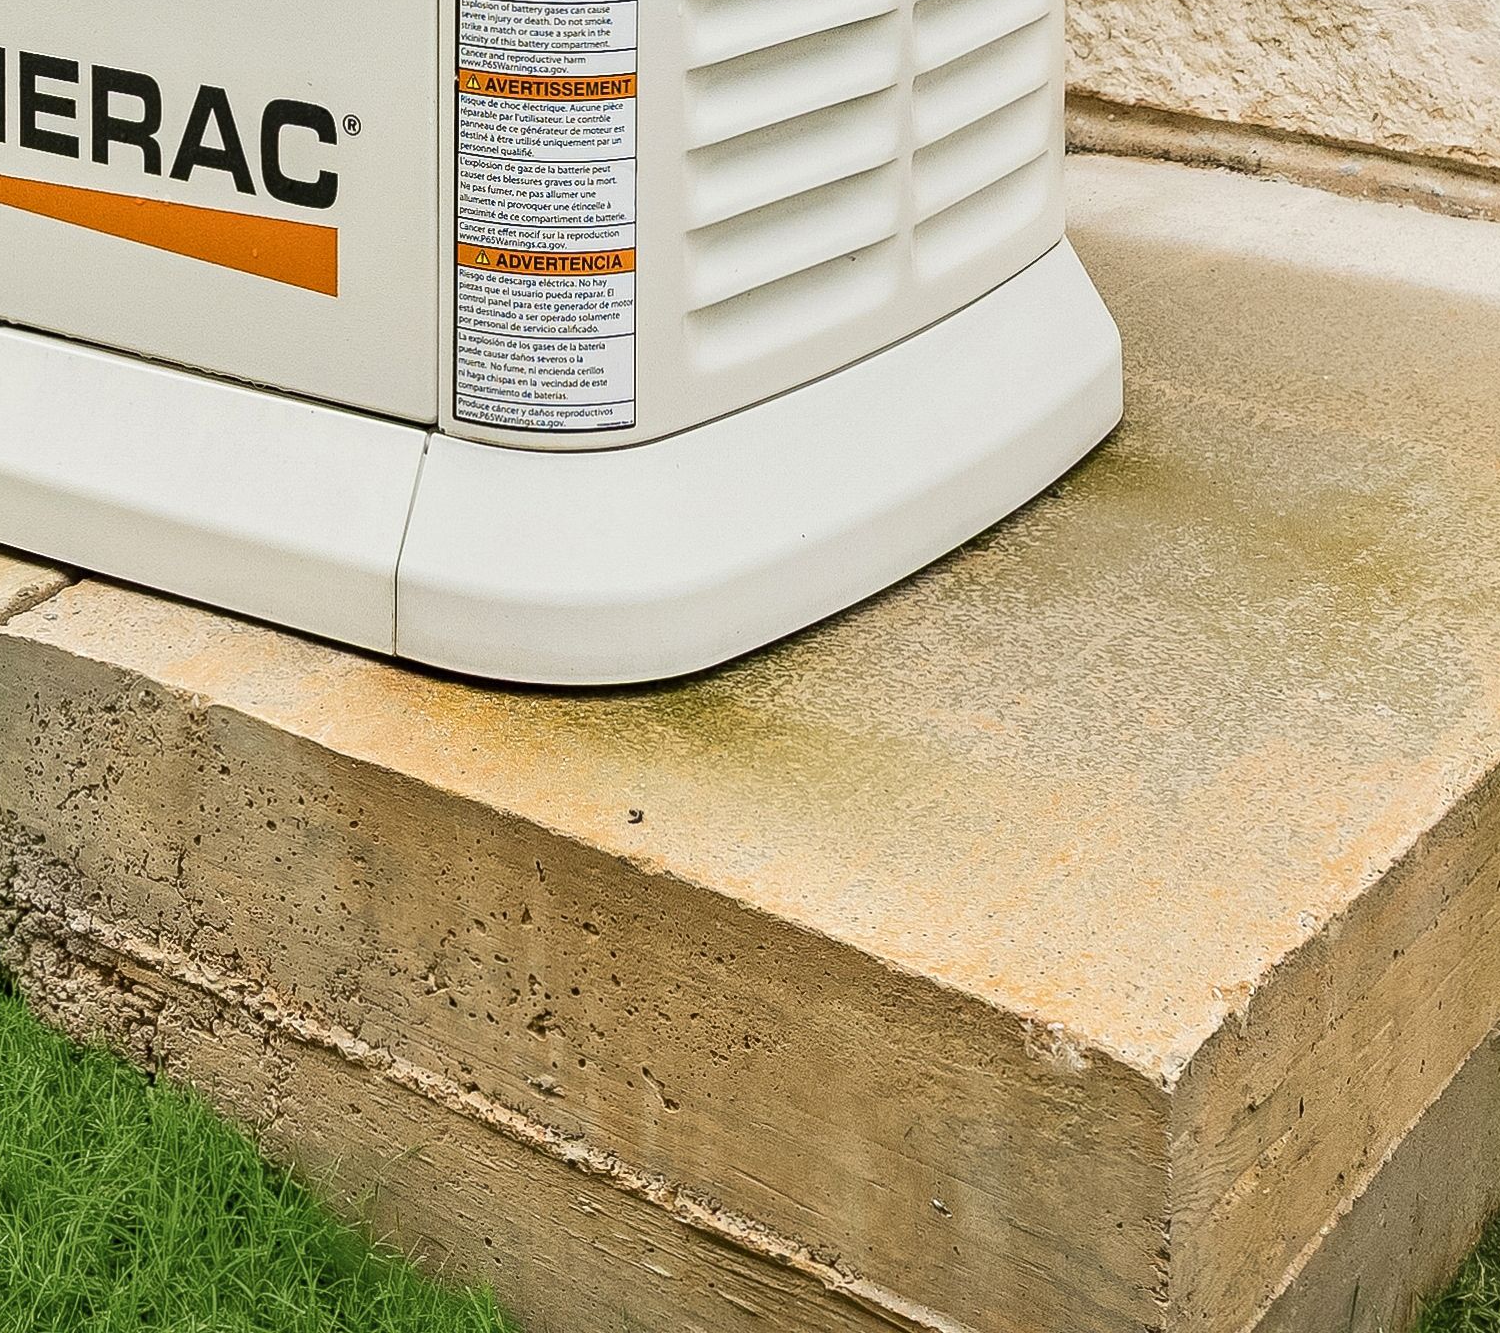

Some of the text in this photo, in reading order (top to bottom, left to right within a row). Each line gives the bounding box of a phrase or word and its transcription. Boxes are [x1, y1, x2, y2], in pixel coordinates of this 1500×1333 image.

[462, 11, 486, 20] severe
[488, 13, 511, 24] injury
[525, 16, 550, 25] death.
[554, 17, 566, 25] Do
[569, 17, 582, 25] not
[585, 17, 612, 25] smoke,
[501, 3, 510, 11] of
[512, 4, 541, 14] battery
[545, 6, 568, 15] gases
[462, 21, 482, 31] strike
[490, 25, 516, 35] match
[530, 29, 553, 37] cause
[563, 29, 585, 38] spark
[461, 34, 610, 49] vicinity of this battery compartment.
[461, 48, 585, 64] Cancer and reproductive harm
[485, 78, 631, 96] AVERTISSEMENT
[461, 95, 486, 107] Risque
[488, 99, 498, 108] de
[500, 101, 520, 110] choc
[570, 103, 600, 111] Aucune
[460, 157, 610, 175] L'explosion de gaz de la batterie peut
[460, 221, 619, 241] Cancer et effet nocif sur la reproduction
[496, 254, 622, 271] ADVERTENCIA
[460, 269, 484, 281] Riesgo
[486, 274, 496, 282] de
[499, 275, 536, 287] descarga
[579, 279, 591, 287] No
[593, 278, 607, 288] hay
[459, 282, 614, 300] piezas que el usuario pueda reparar. El
[459, 293, 633, 312] control panel para este generador de motor
[459, 332, 466, 340] La
[507, 340, 517, 348] de
[519, 340, 530, 349] los
[532, 342, 555, 352] gases
[558, 342, 568, 350] de
[570, 342, 576, 351] la
[458, 397, 489, 411] Produce
[521, 409, 527, 417] y
[557, 408, 613, 419] reproductivos
